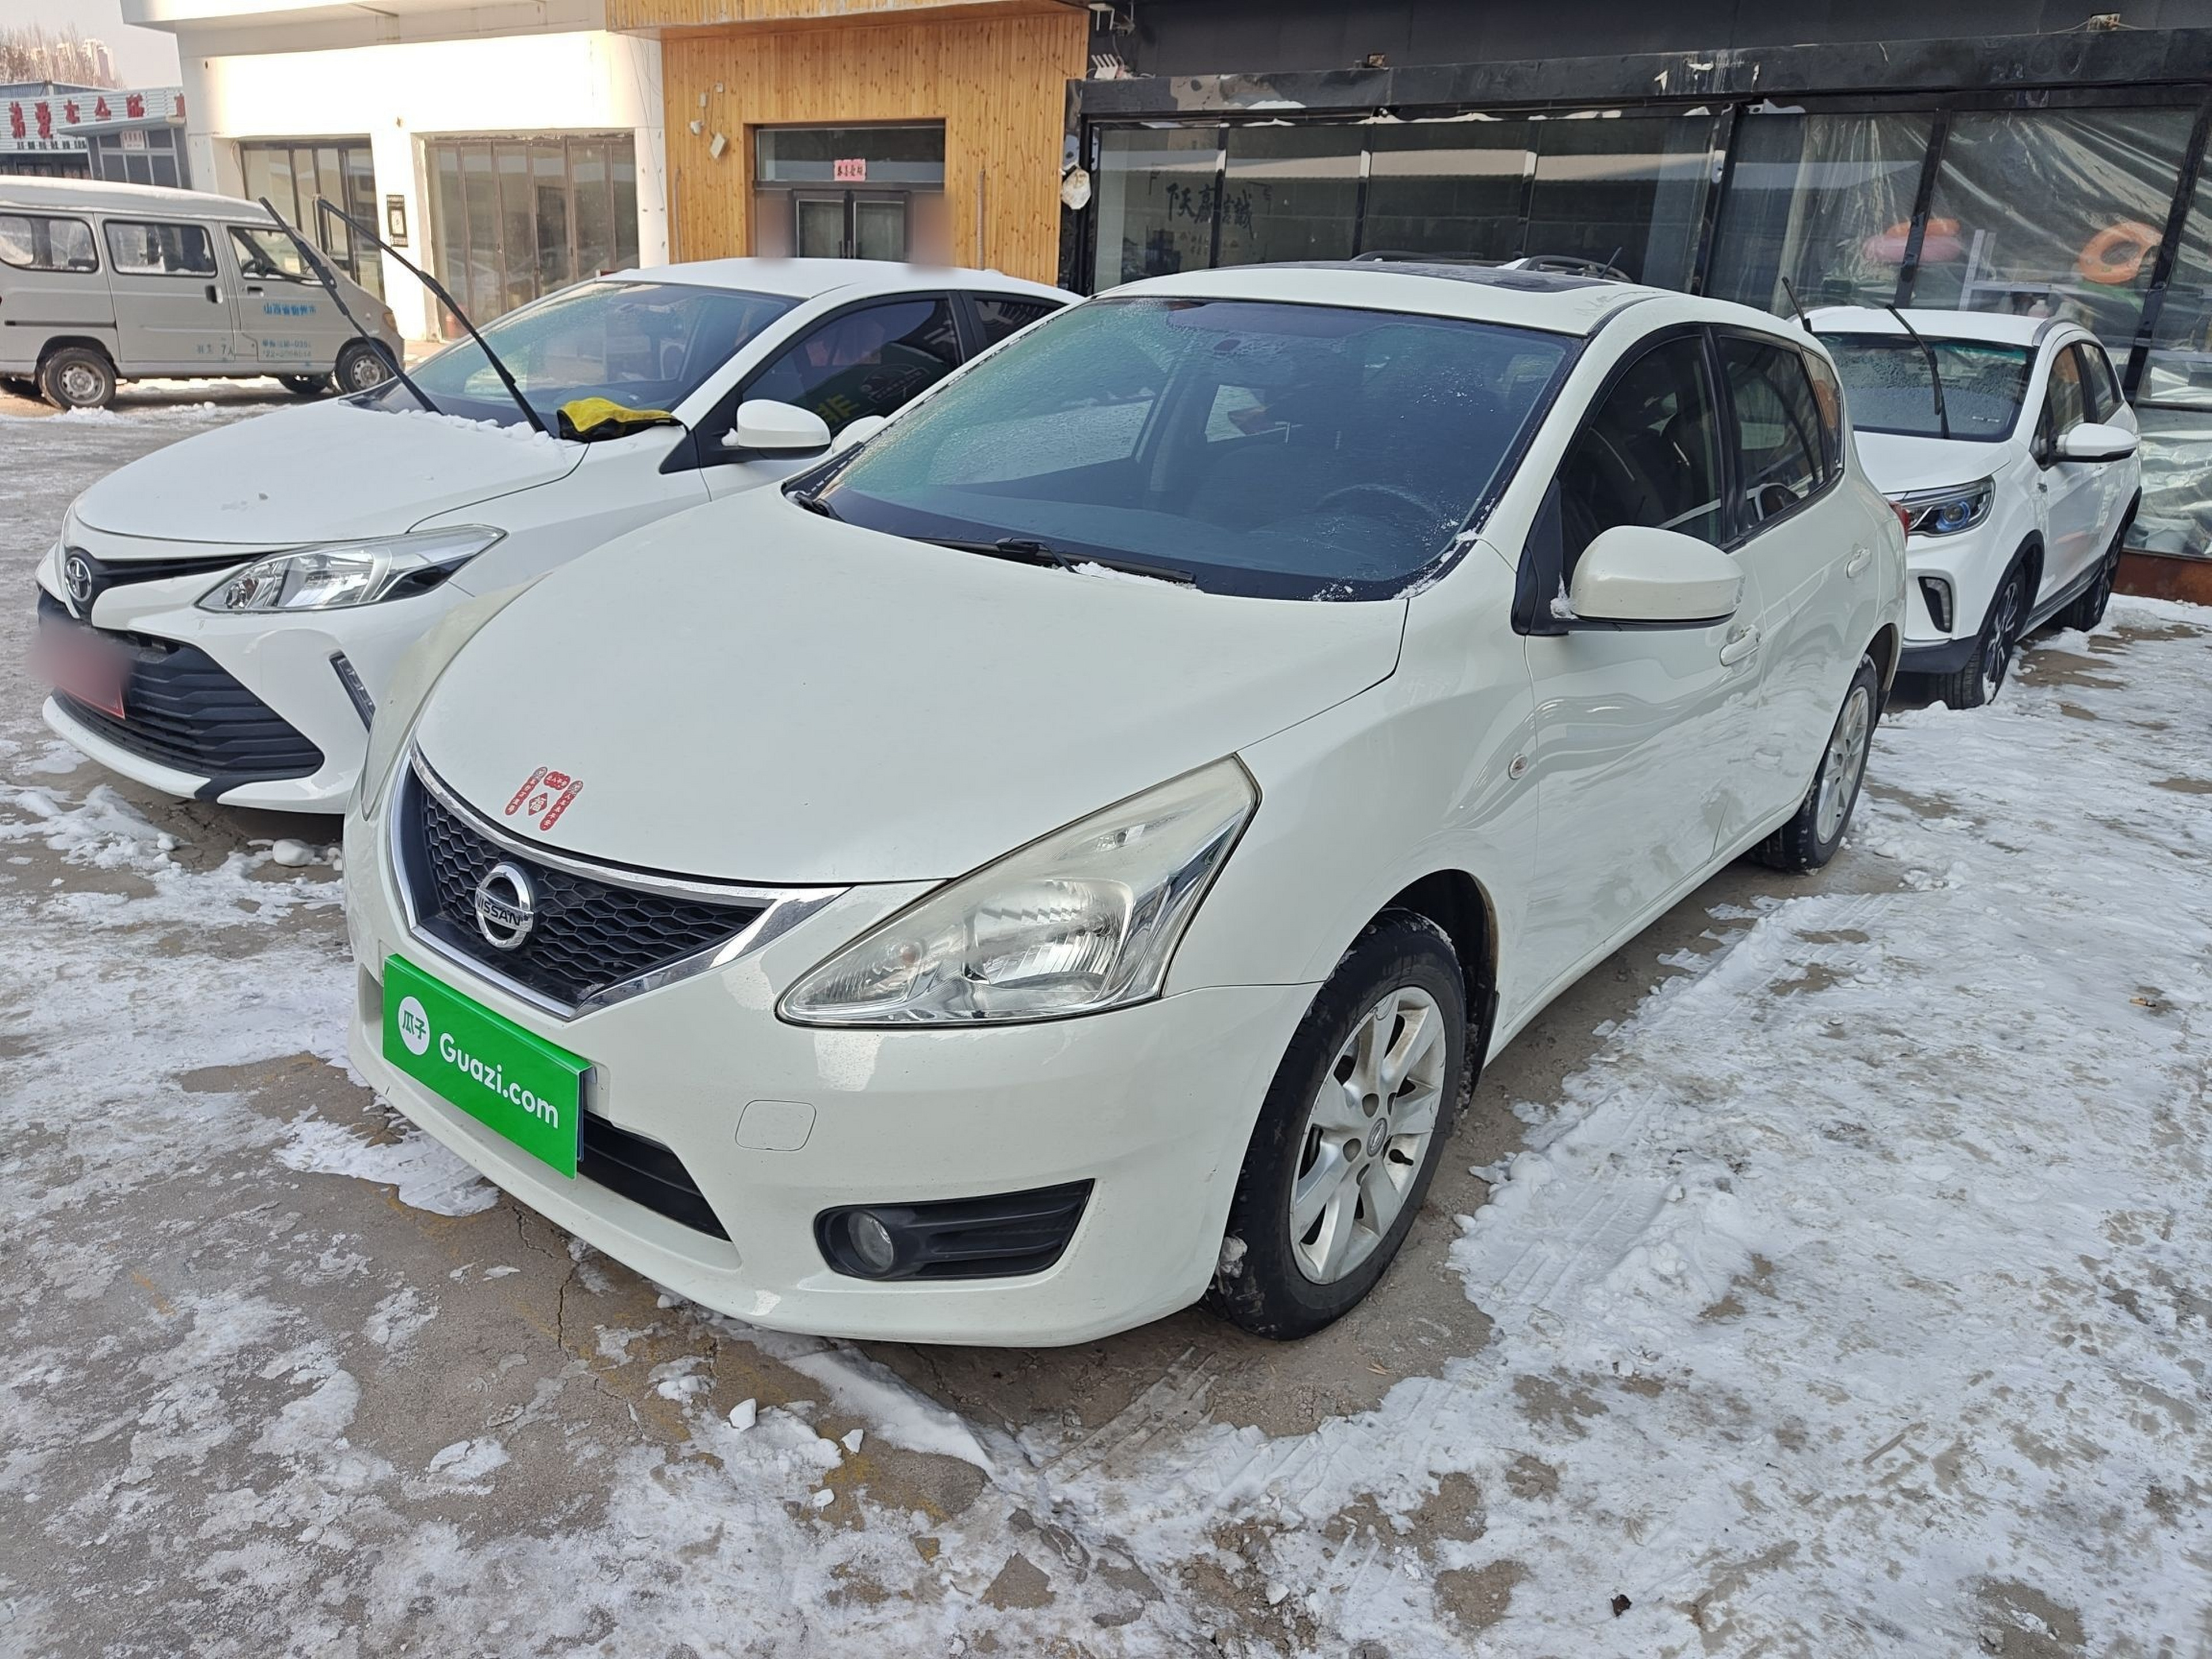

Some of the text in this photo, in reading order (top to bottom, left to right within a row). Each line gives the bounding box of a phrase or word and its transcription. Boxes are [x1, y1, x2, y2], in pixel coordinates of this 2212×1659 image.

[476, 893, 520, 926] NISSAN
[403, 1009, 427, 1040] 瓜子
[439, 1032, 559, 1129] Guazi.com
